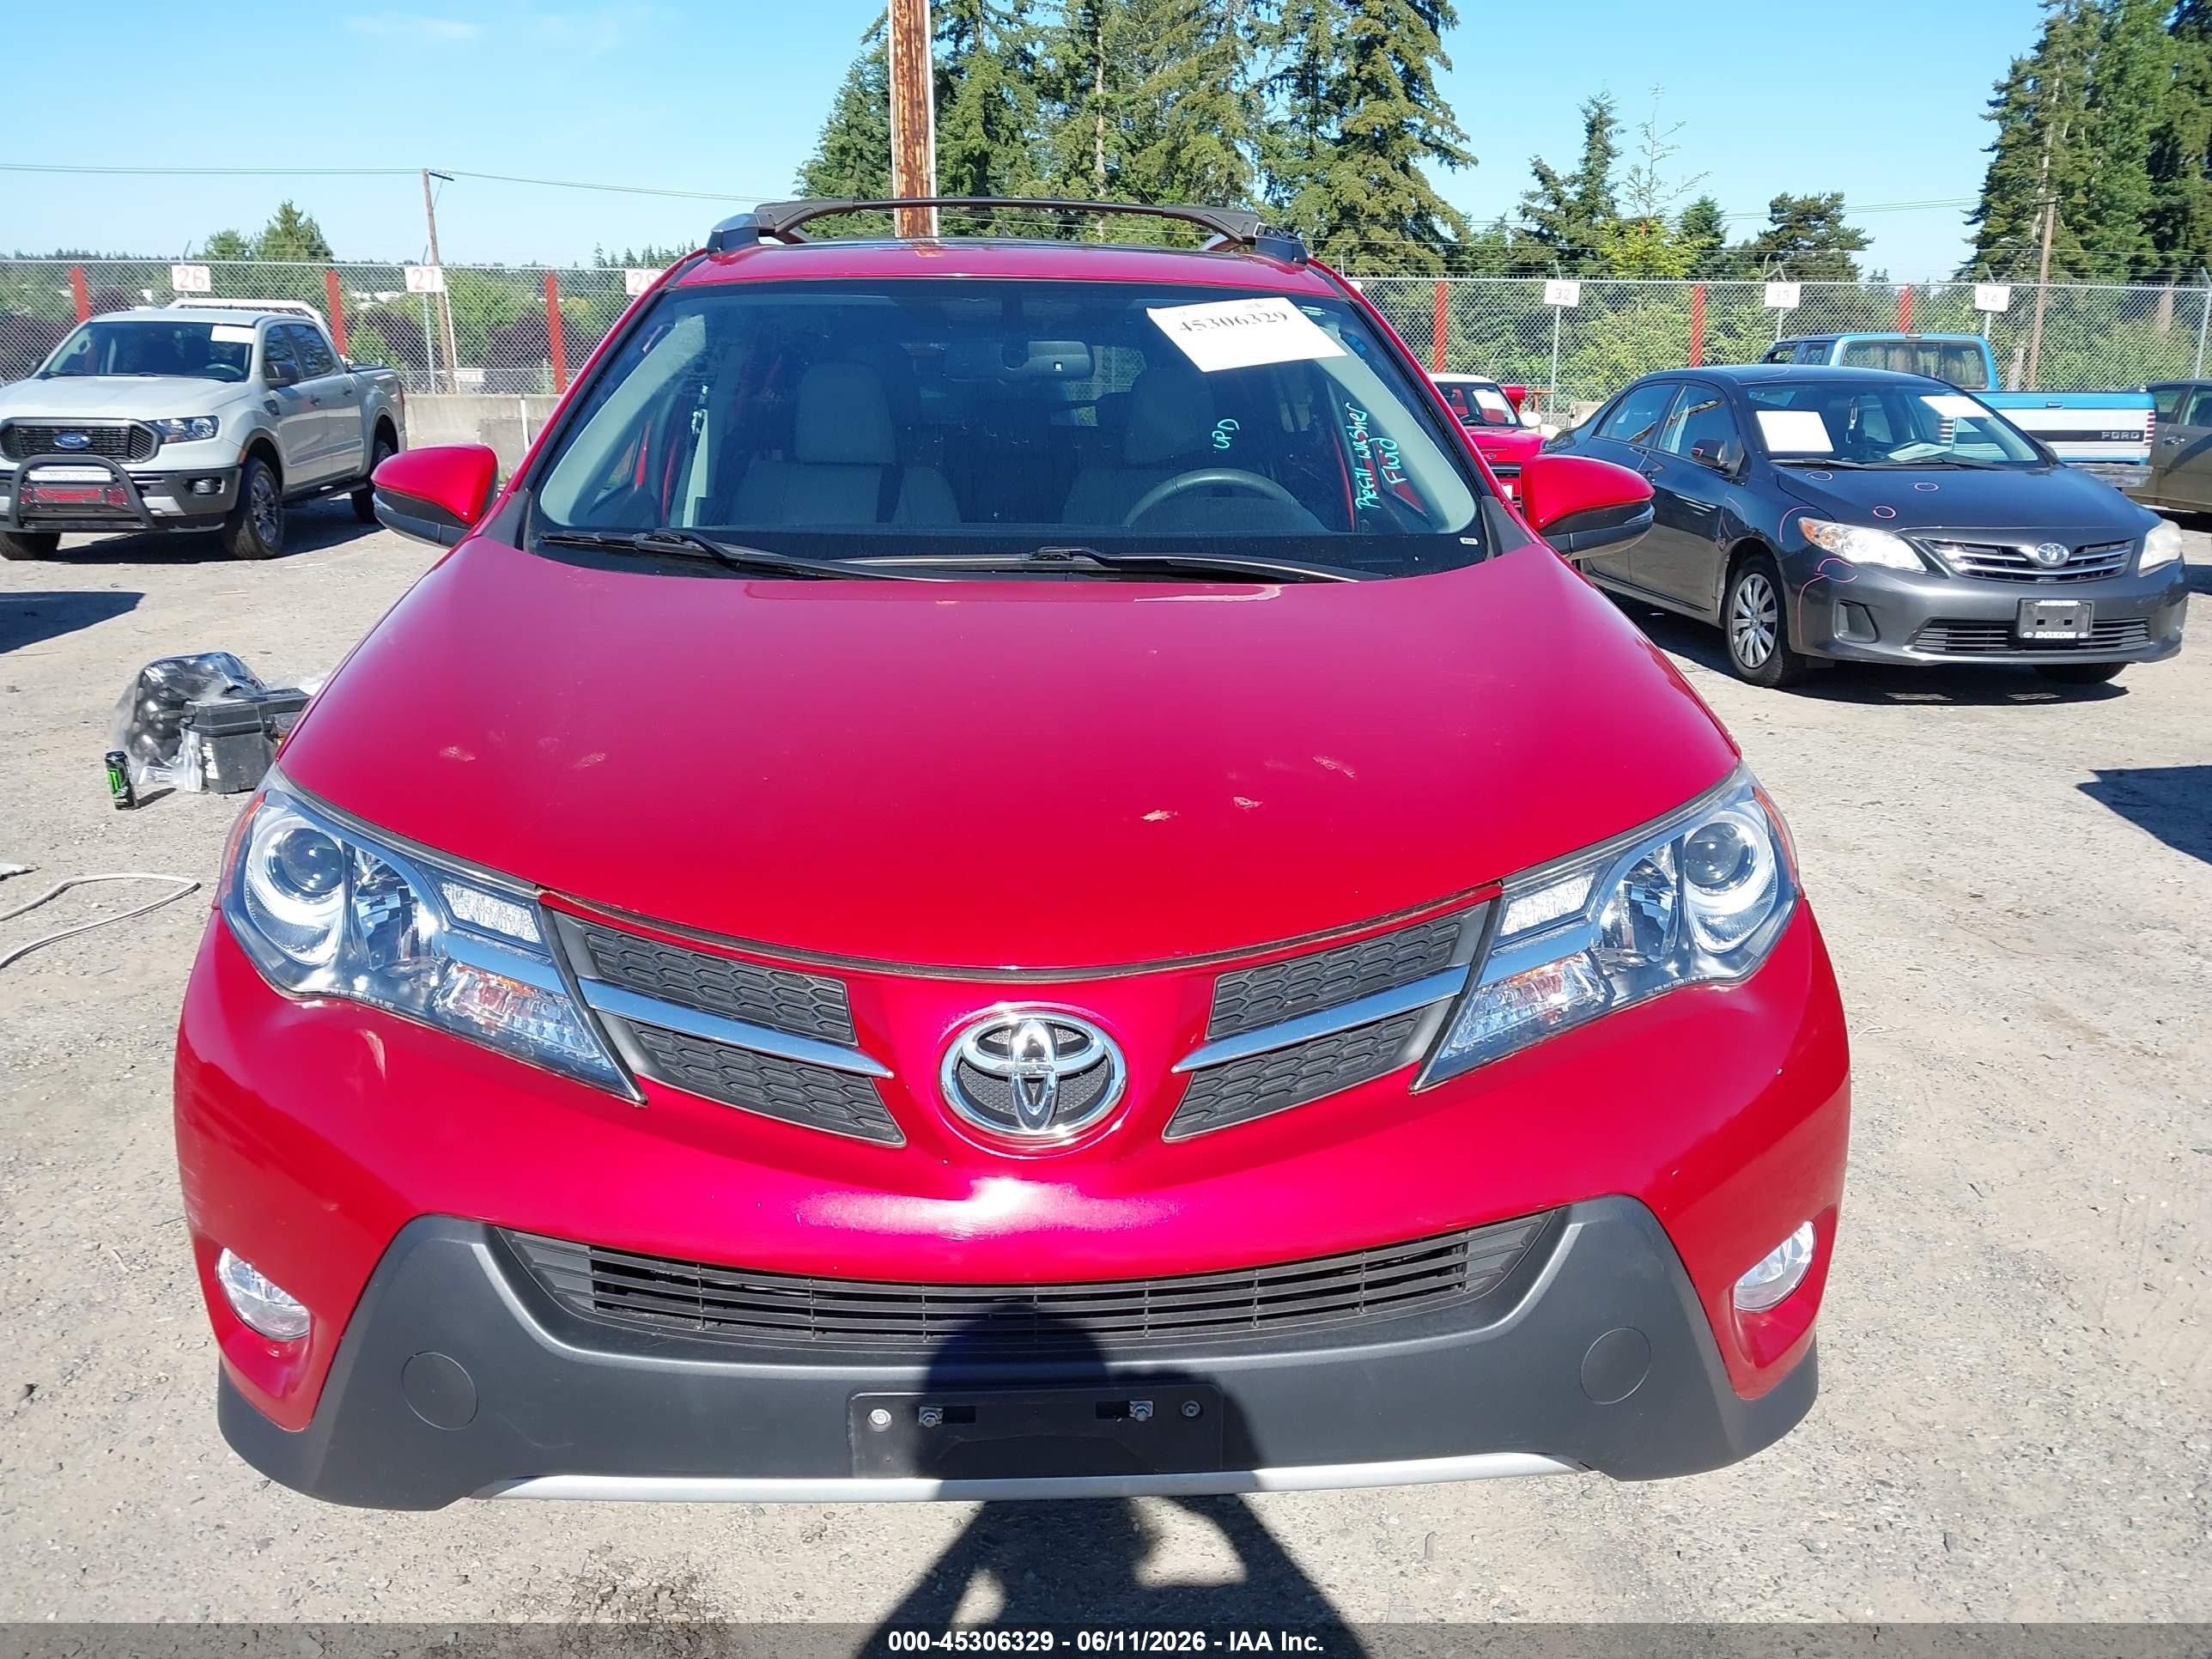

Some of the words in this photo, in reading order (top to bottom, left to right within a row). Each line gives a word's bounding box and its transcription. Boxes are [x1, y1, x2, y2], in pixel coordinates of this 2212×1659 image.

[178, 267, 205, 289] 26
[412, 268, 434, 289] 27
[1555, 288, 1571, 301] 32
[1180, 311, 1288, 332] 45306329
[2101, 431, 2140, 440] FORD
